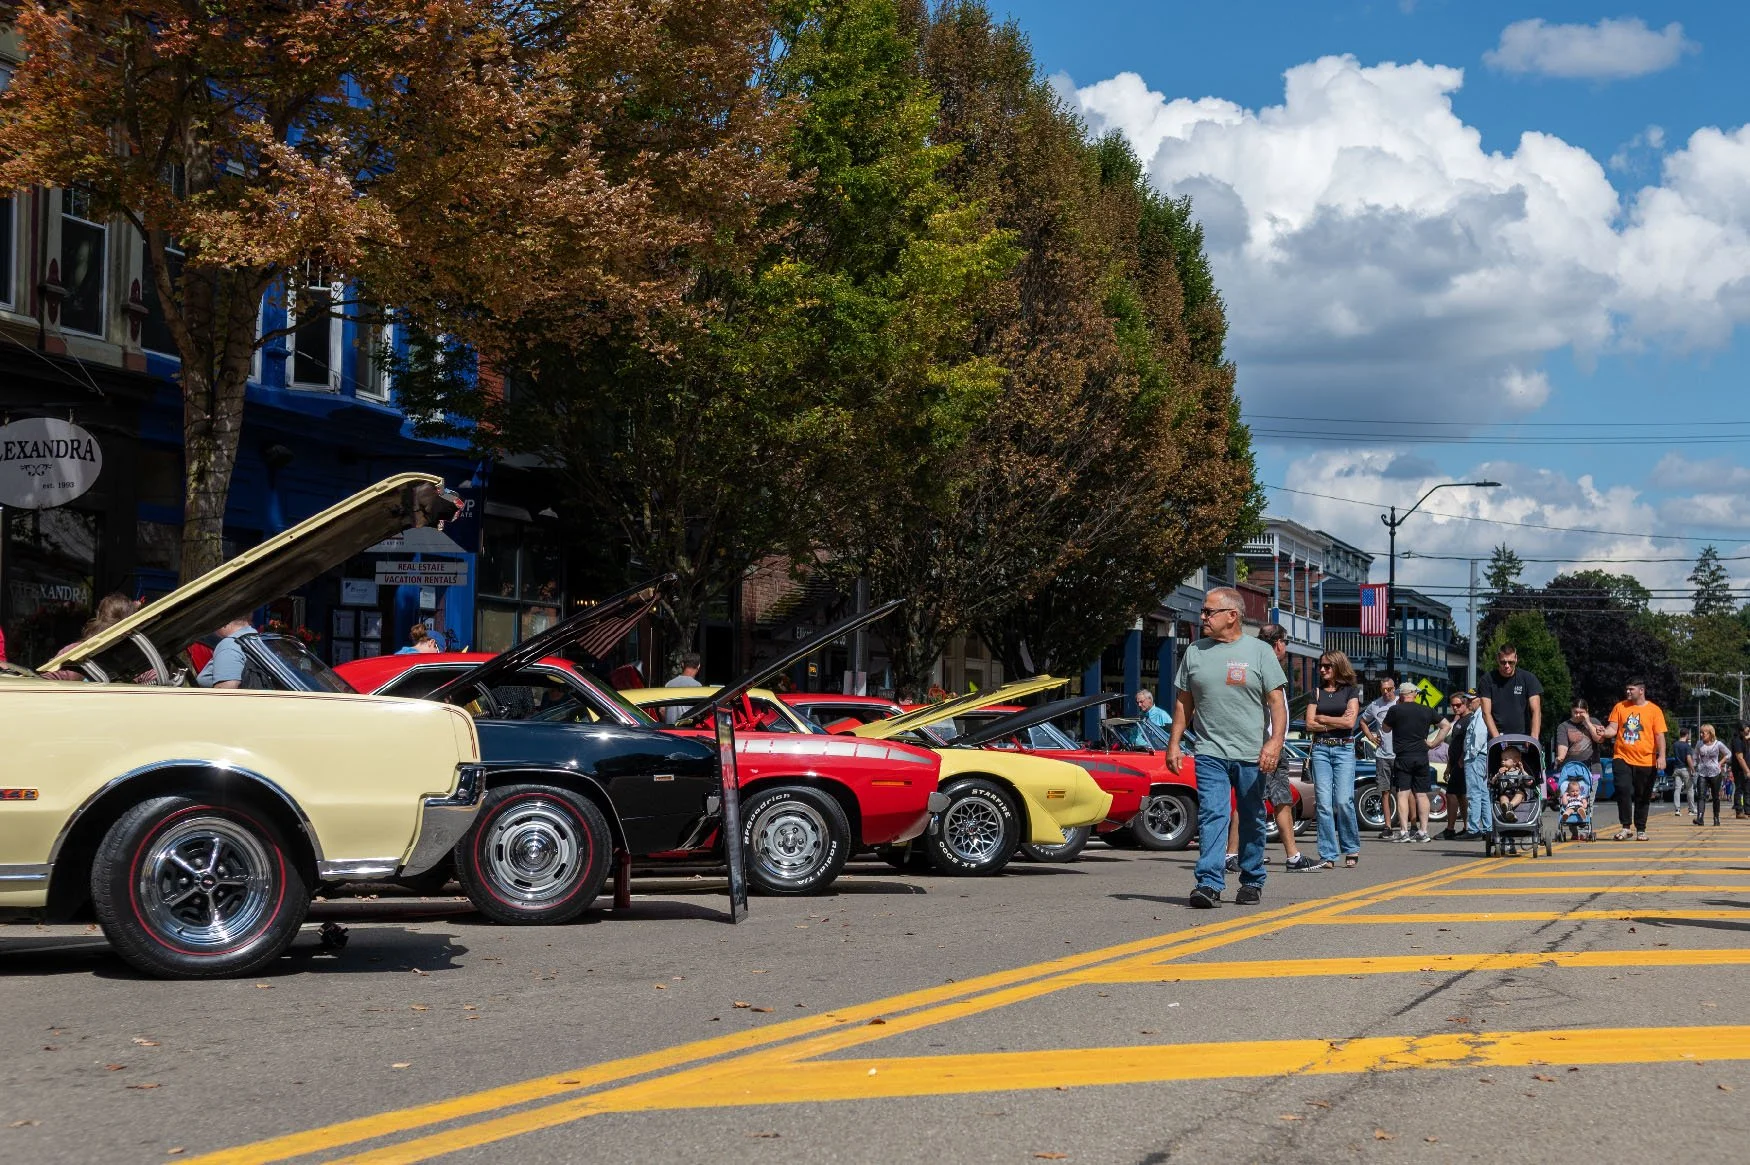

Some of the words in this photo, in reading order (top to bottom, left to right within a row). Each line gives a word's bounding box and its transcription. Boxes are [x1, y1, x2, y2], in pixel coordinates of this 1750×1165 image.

[398, 563, 416, 571] REAL
[418, 563, 445, 571] ESTATE
[384, 575, 422, 584] VACATION
[424, 576, 457, 584] RENTALS
[971, 788, 1011, 819] STARFIRE
[817, 840, 837, 876] Radial
[939, 841, 959, 864] 5000
[797, 876, 815, 885] T/A
